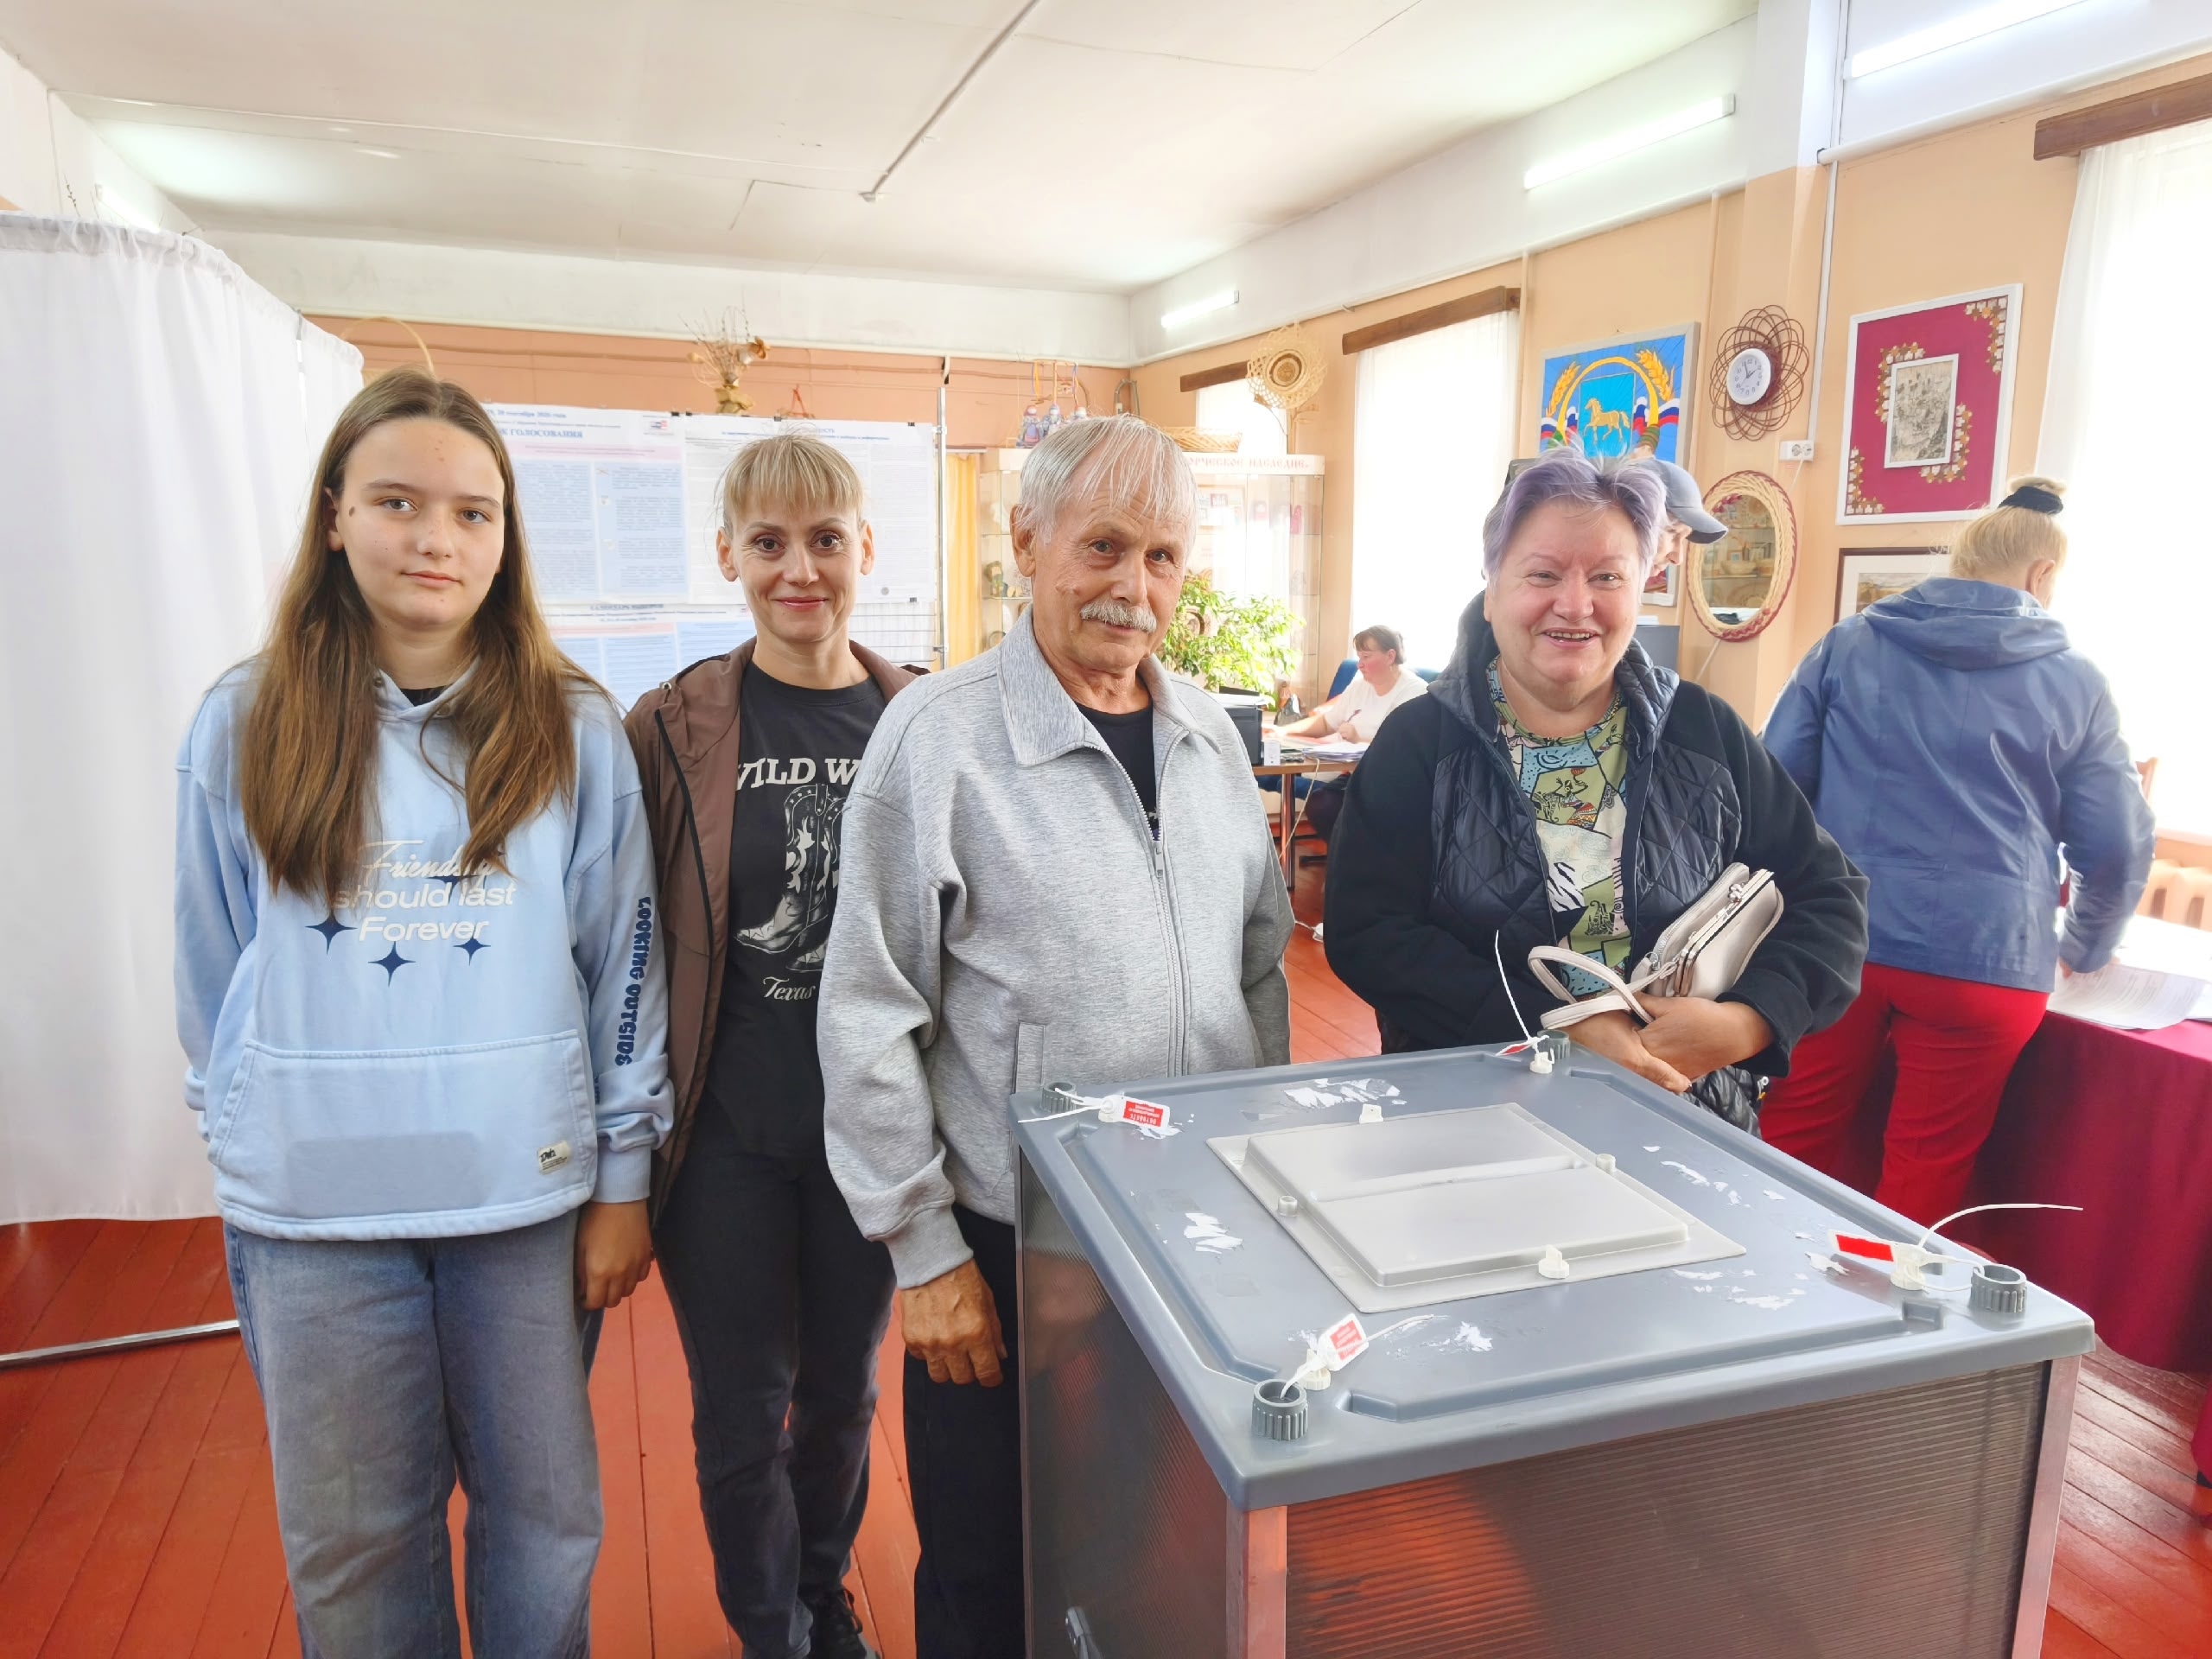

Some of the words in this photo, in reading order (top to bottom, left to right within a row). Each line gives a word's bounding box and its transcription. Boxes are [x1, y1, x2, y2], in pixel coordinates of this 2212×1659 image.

[510, 429, 583, 438] ГОЛОСОВАНИЯ
[823, 758, 862, 785] W
[334, 882, 453, 908] should
[458, 882, 517, 906] last
[359, 916, 490, 942] Forever
[629, 896, 652, 981] LOOKING
[762, 976, 816, 1001] Texas
[614, 983, 641, 1067] OUTSIDE
